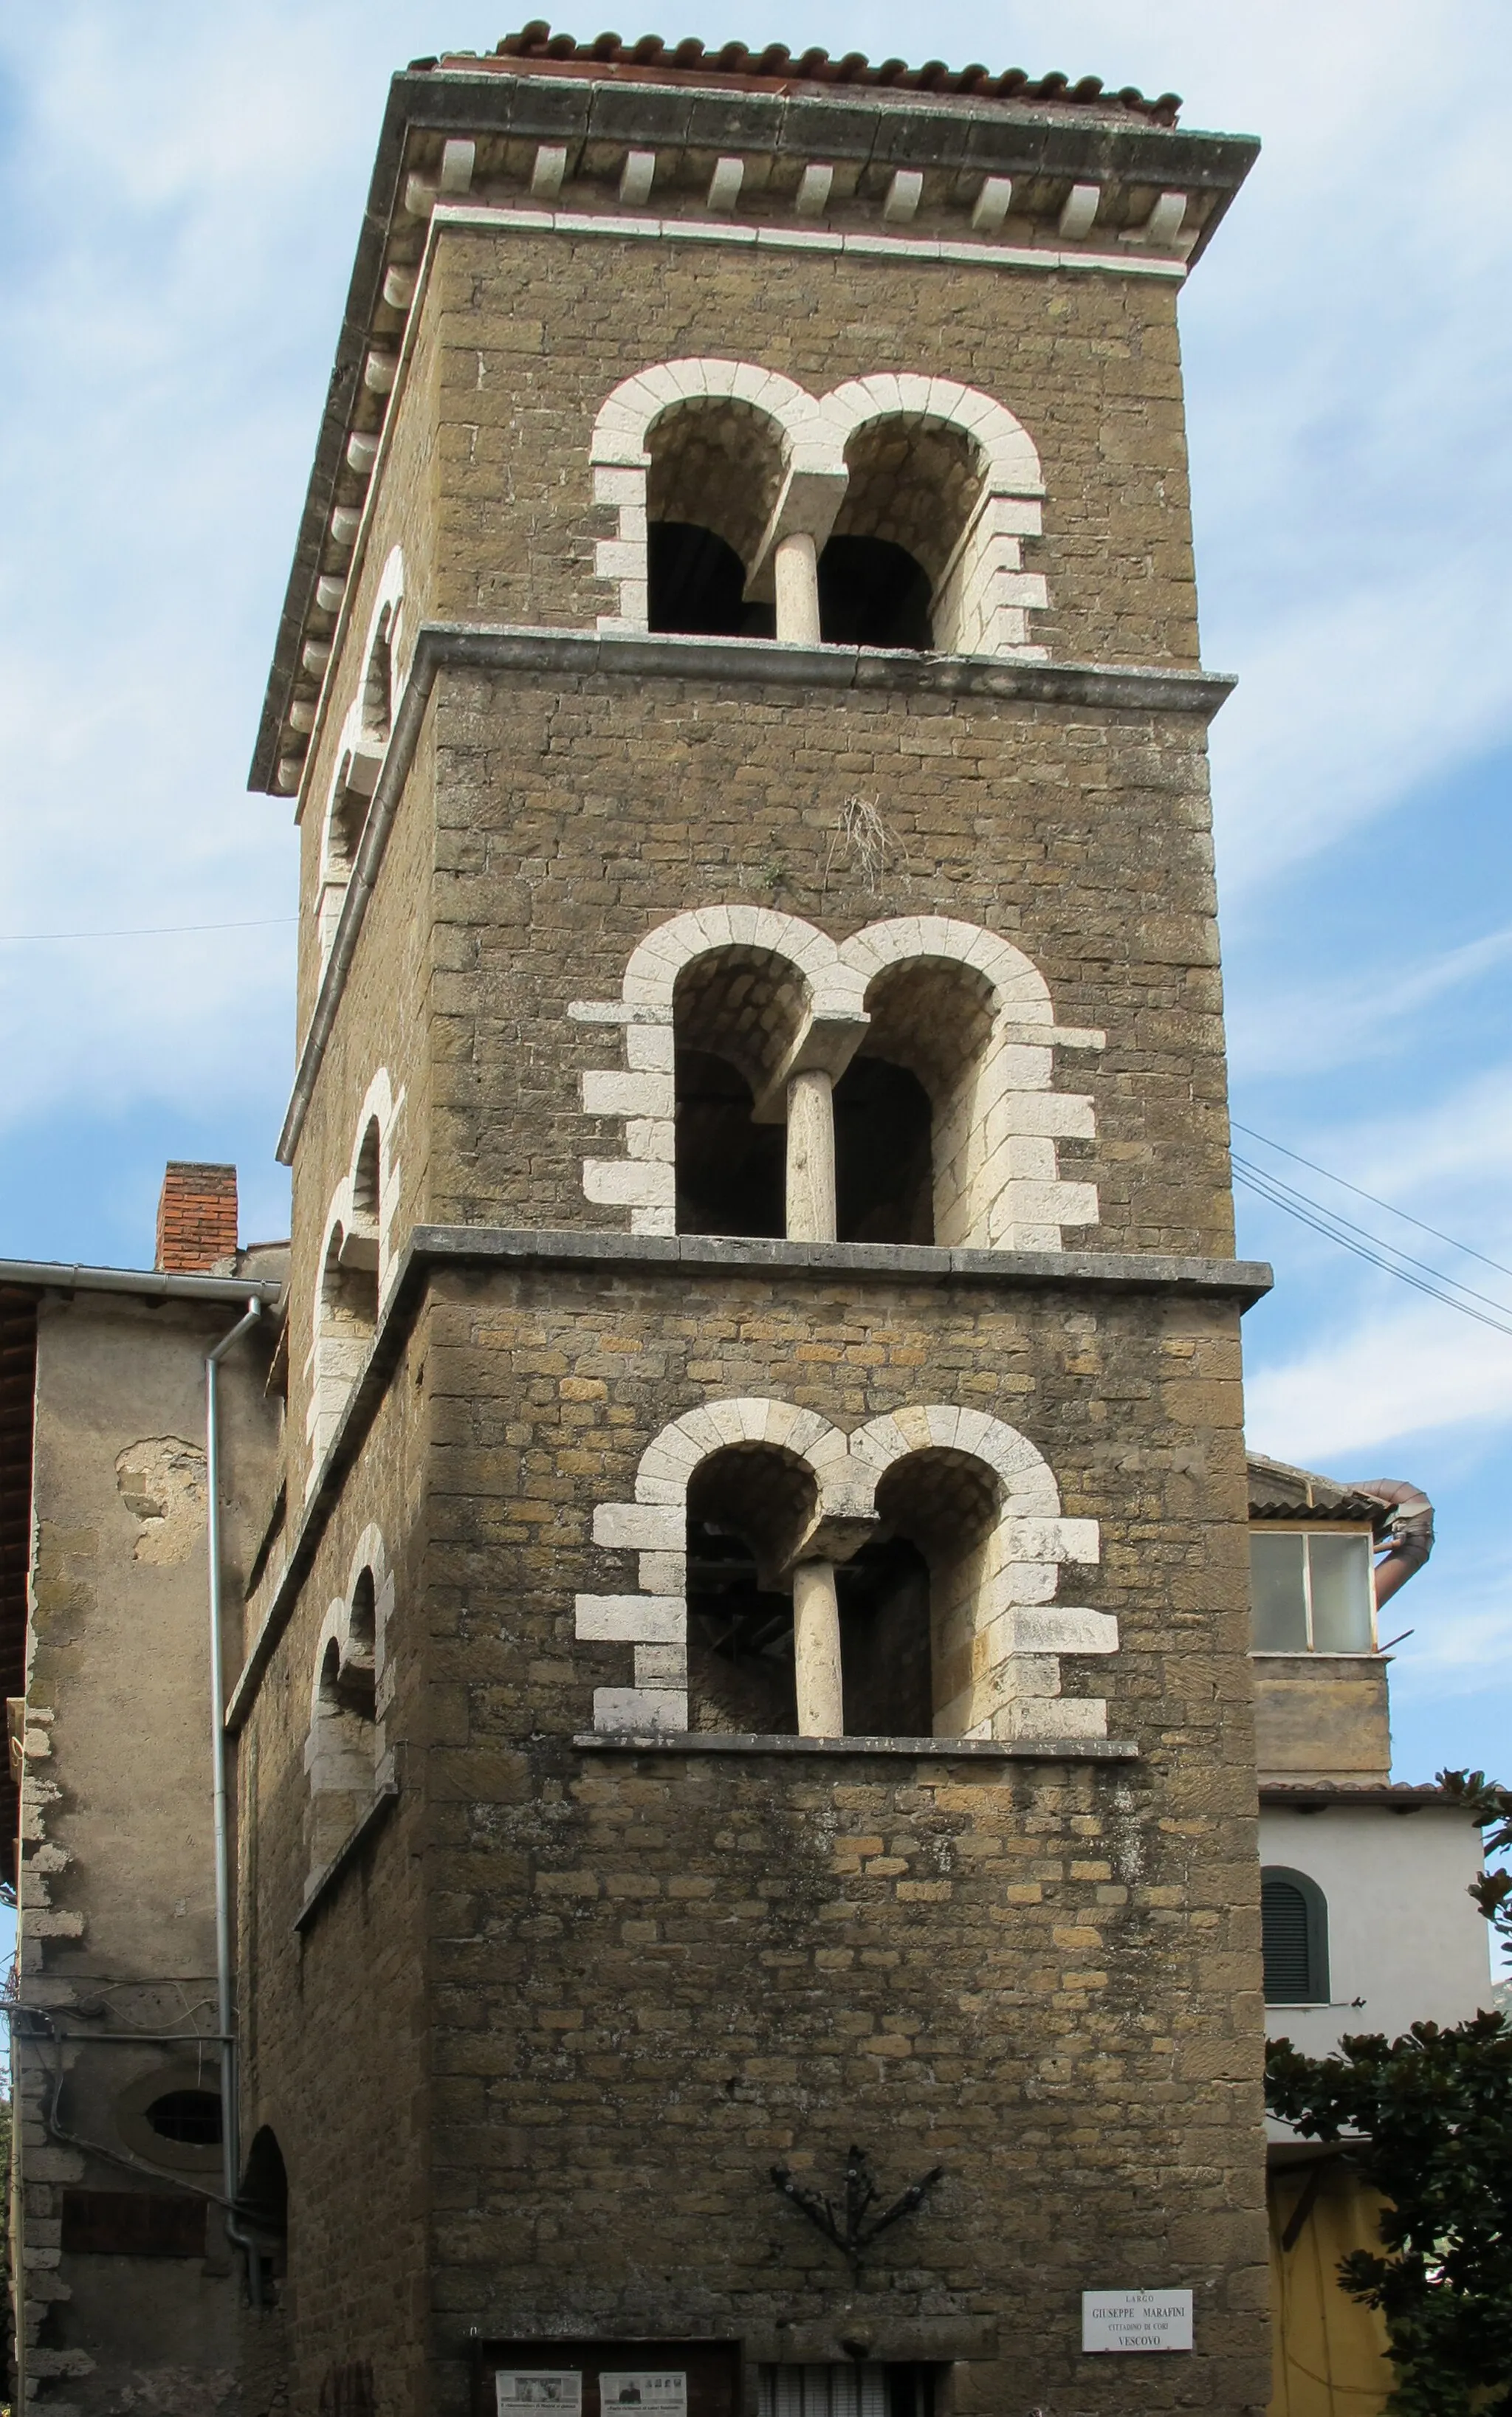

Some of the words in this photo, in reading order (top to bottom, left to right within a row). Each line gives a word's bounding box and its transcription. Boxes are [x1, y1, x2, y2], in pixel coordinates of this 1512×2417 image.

[1093, 2308, 1134, 2318] GIUSEPPE
[1144, 2308, 1184, 2317] MARAFINI
[1118, 2336, 1161, 2346] VESCOVO
